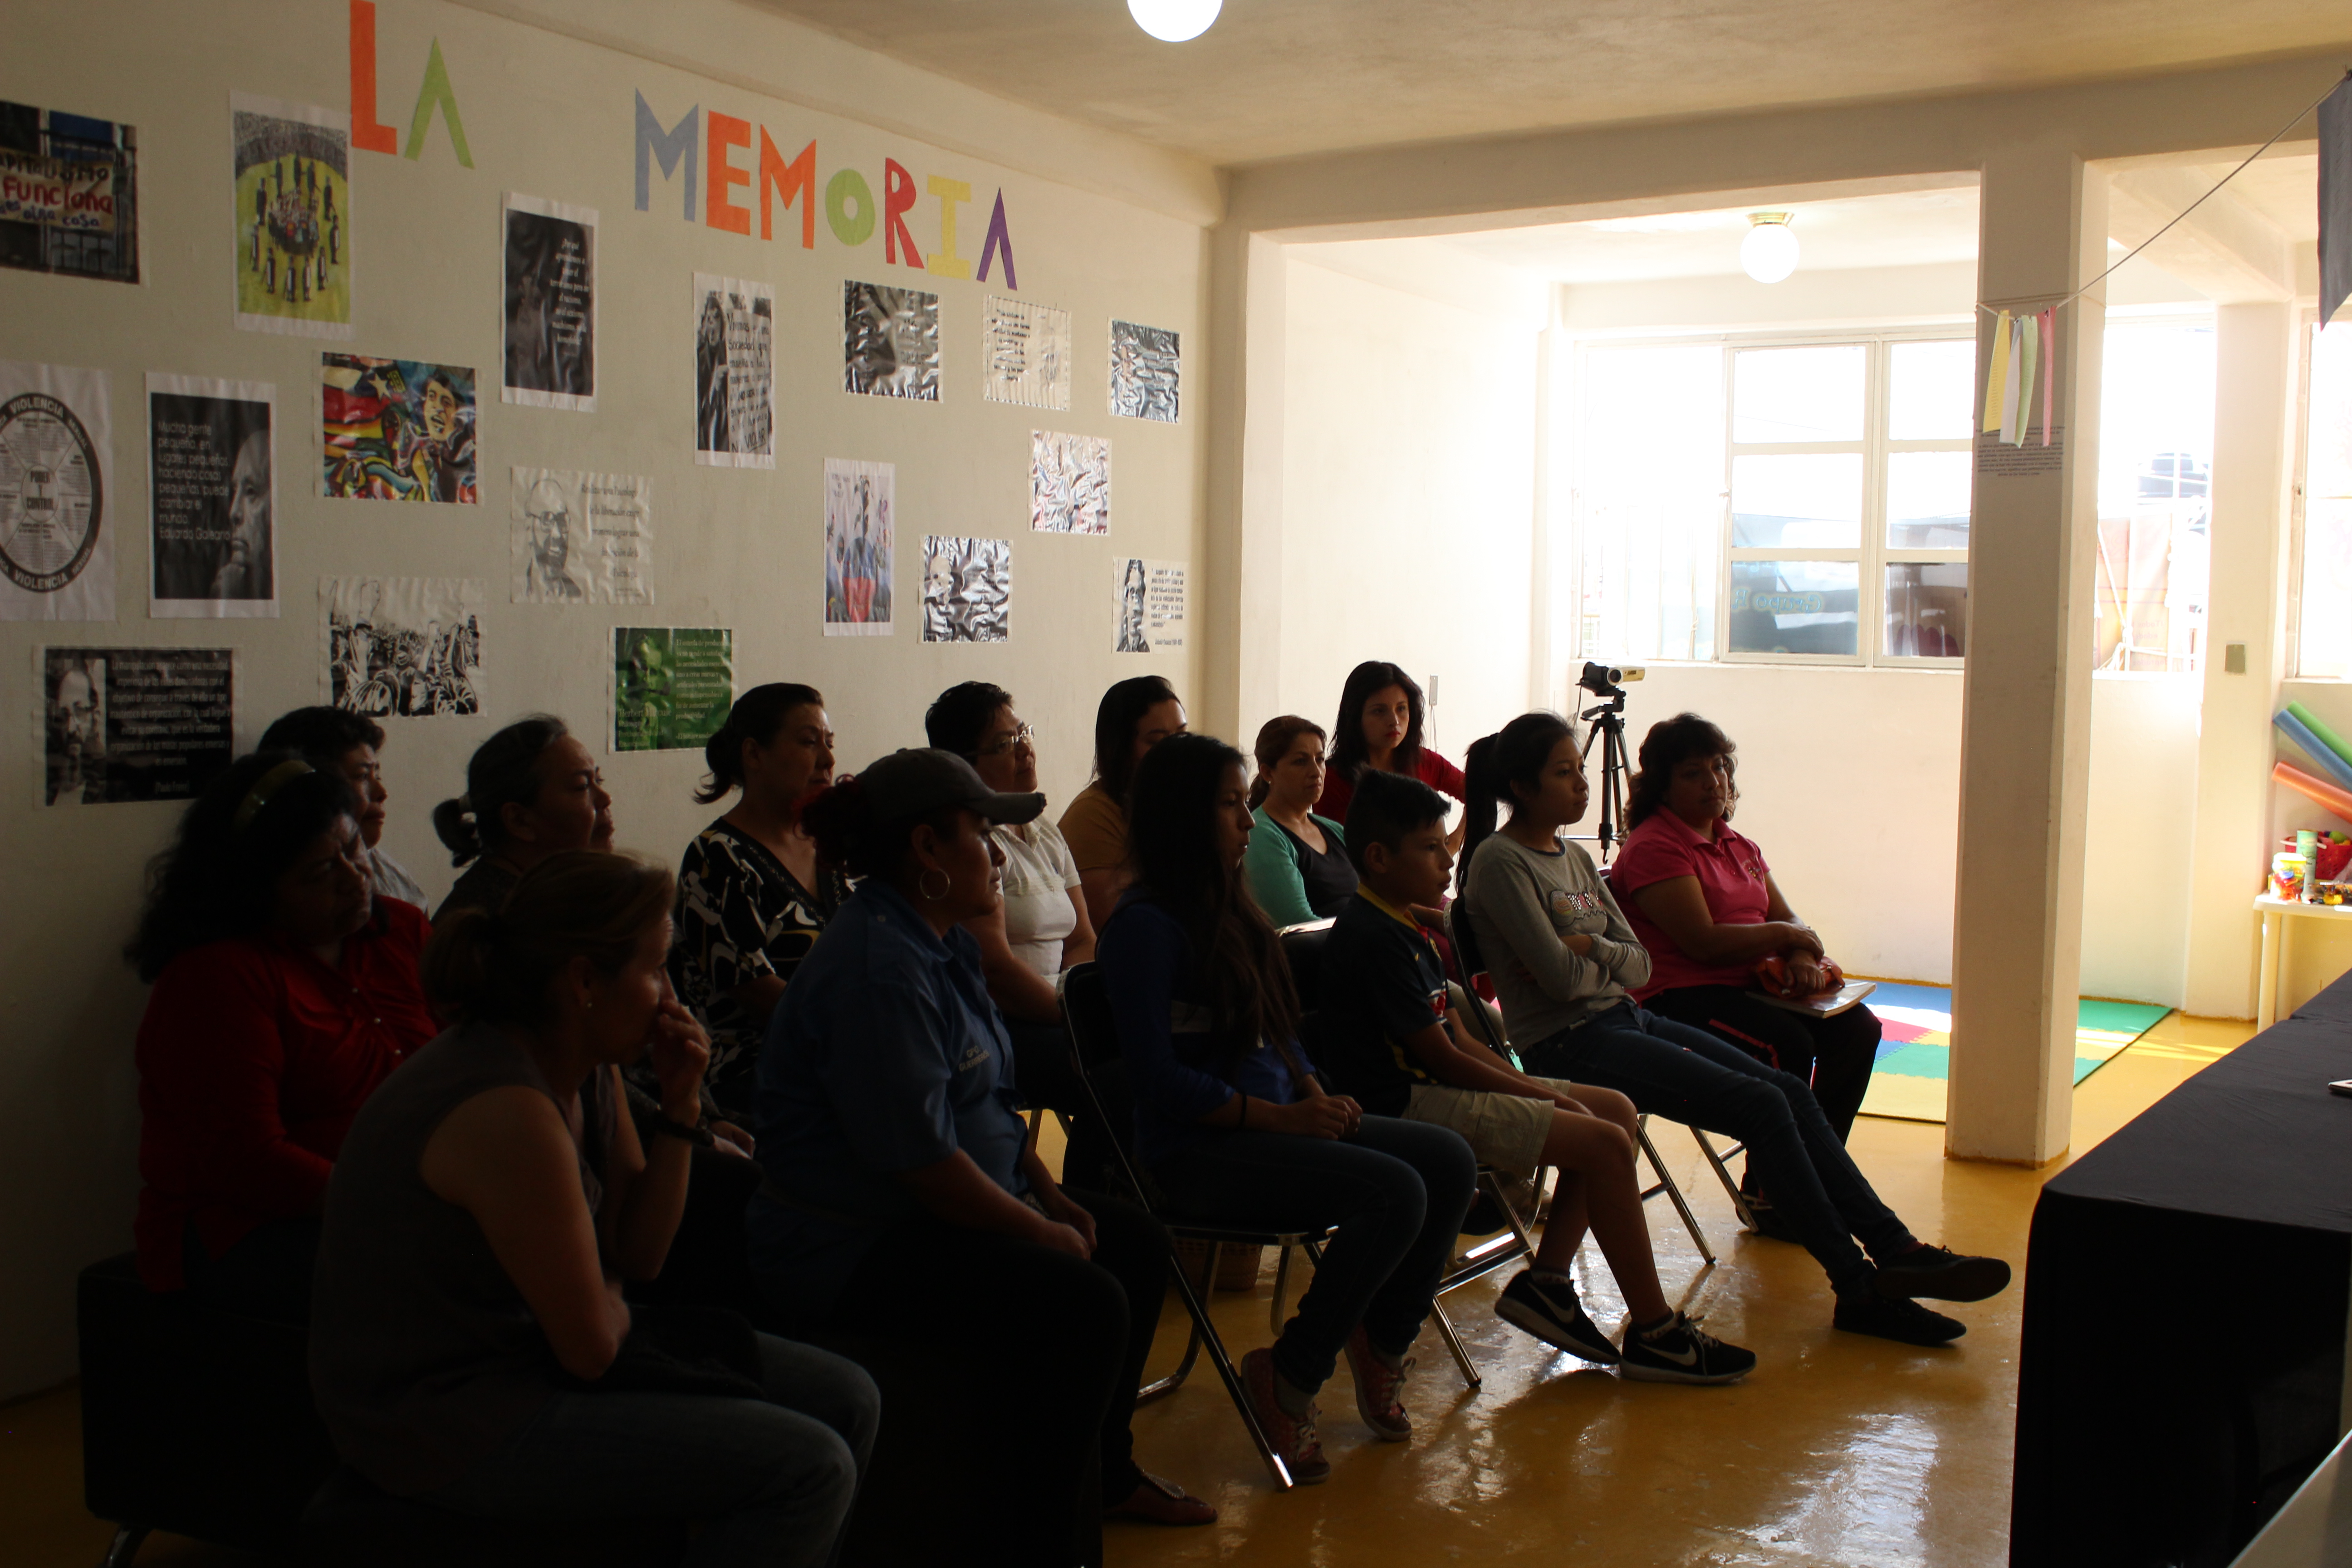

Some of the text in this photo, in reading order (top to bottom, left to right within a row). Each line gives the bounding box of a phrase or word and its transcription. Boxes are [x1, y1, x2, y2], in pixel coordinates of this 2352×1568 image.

[350, 0, 1017, 290] LA MEMORIA
[10, 397, 64, 418] VIOLENCIA
[187, 424, 211, 437] gente
[199, 440, 211, 450] en
[158, 466, 198, 479] haciendo
[201, 485, 230, 498] puede
[159, 526, 230, 541] Eduardo Galeano
[15, 569, 69, 589] VIOLENCIA
